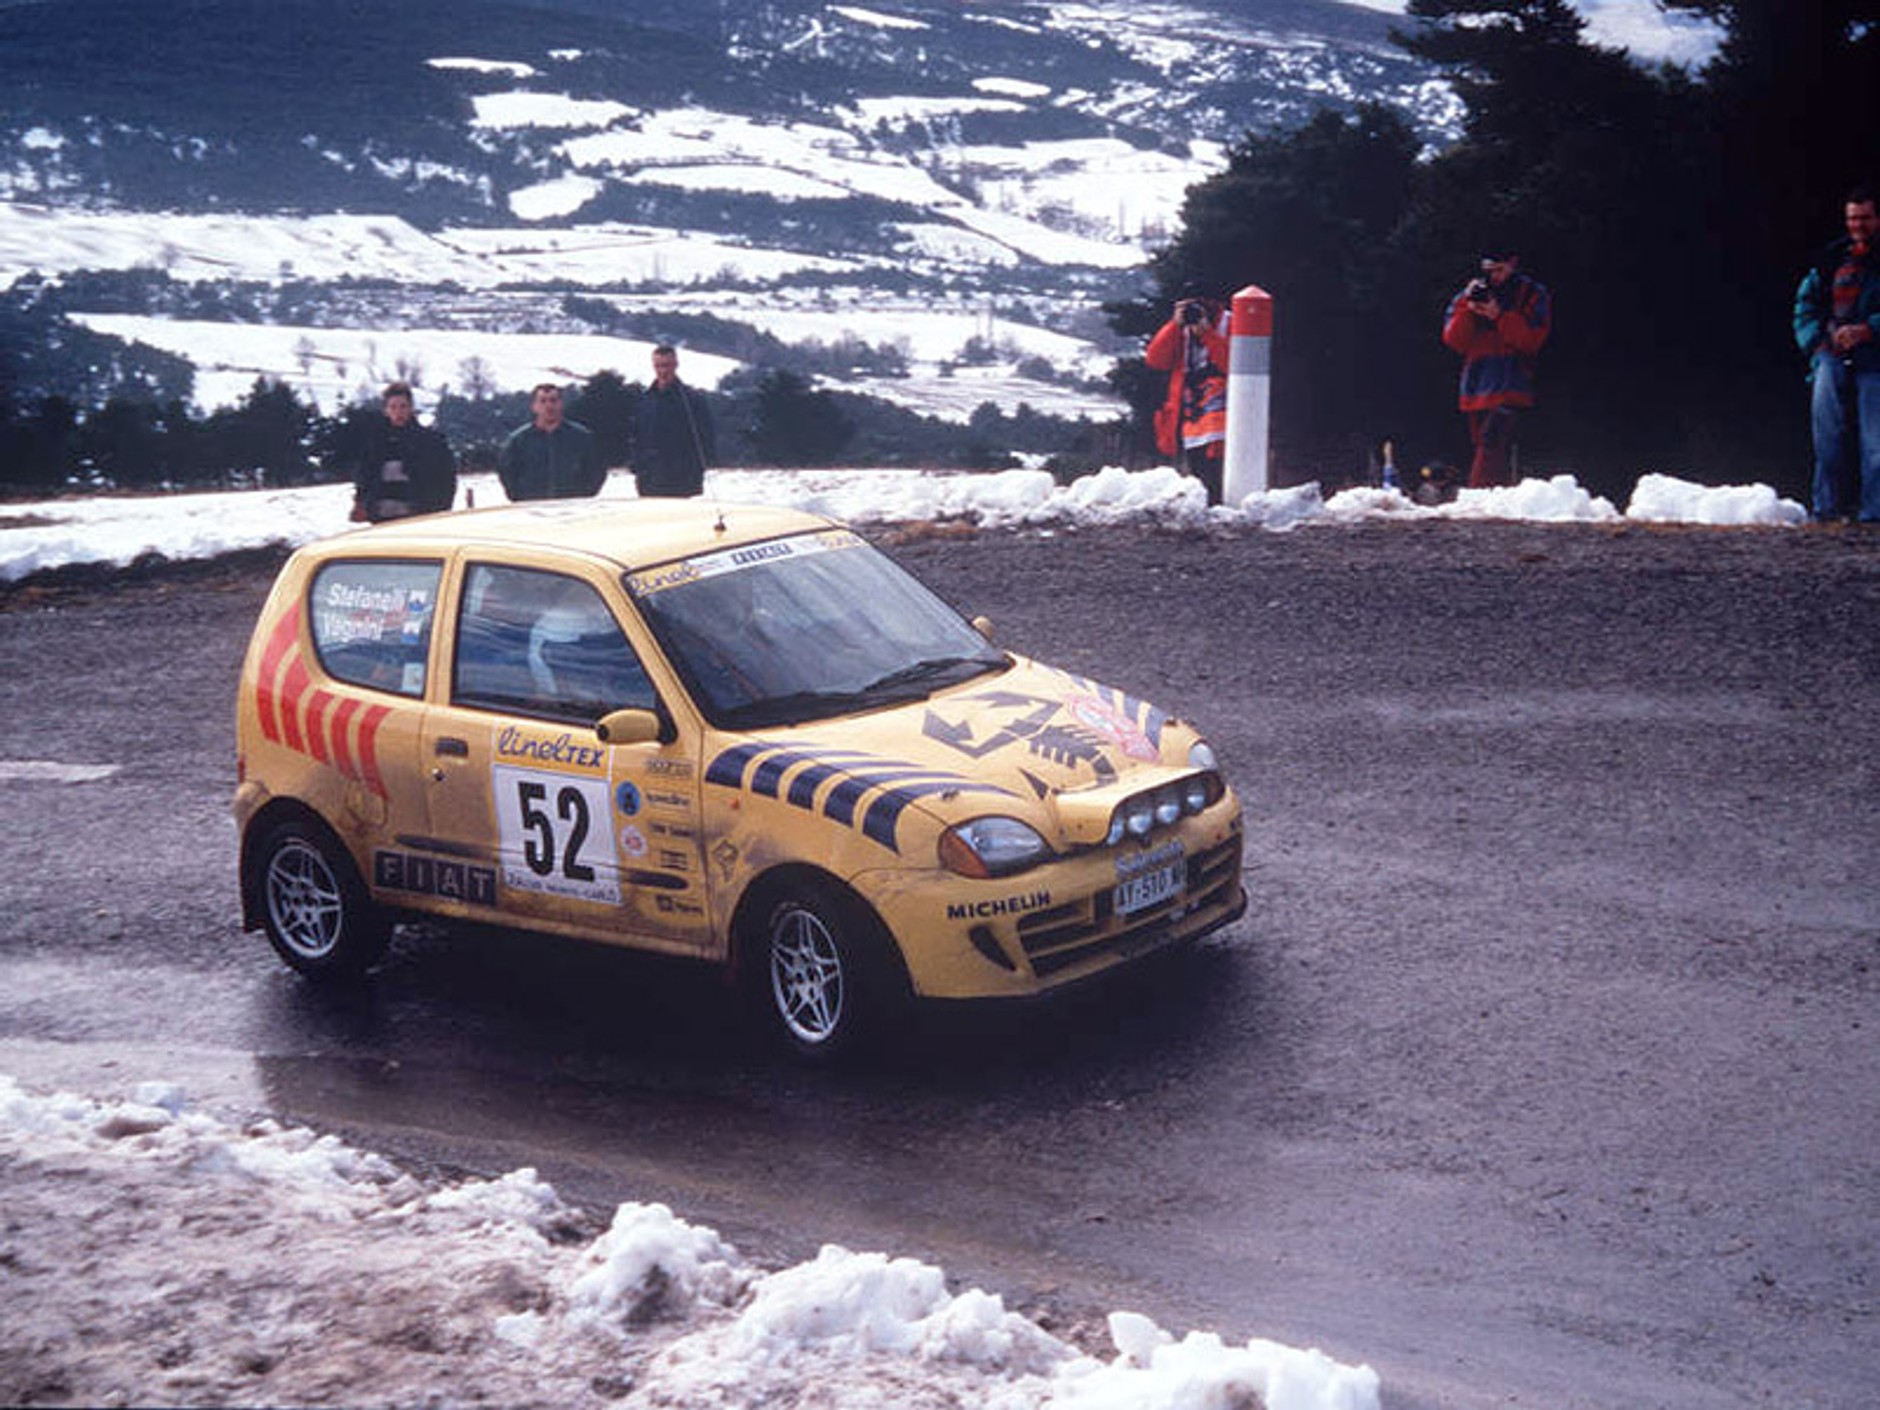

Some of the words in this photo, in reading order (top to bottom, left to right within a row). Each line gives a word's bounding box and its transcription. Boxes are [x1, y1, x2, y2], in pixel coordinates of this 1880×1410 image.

[517, 780, 595, 883] 52
[382, 856, 490, 899] FIAT
[946, 888, 1051, 919] MICHELIN
